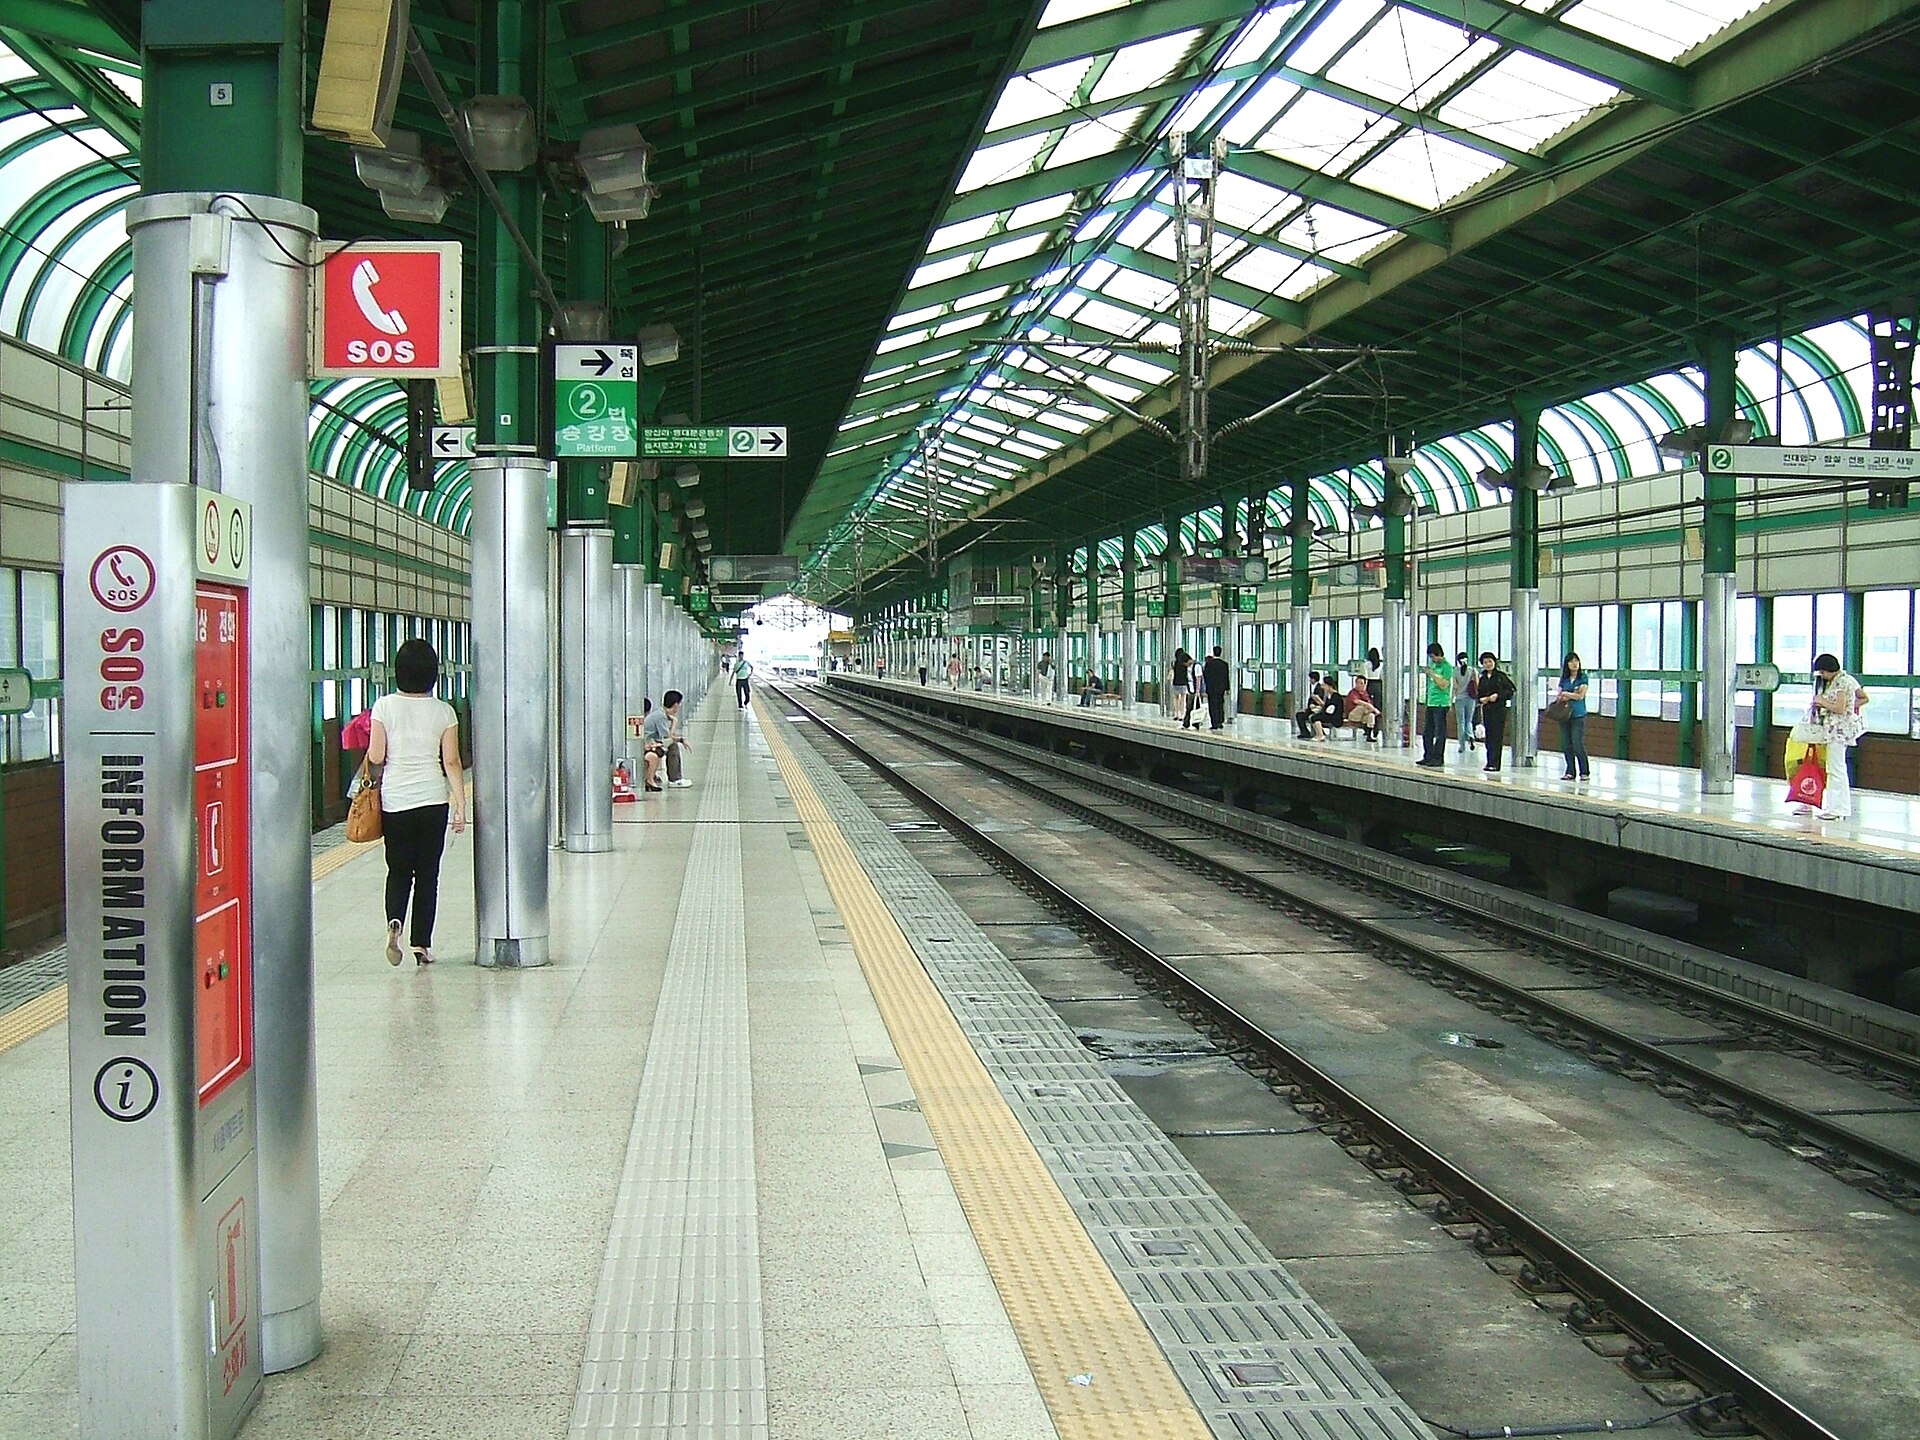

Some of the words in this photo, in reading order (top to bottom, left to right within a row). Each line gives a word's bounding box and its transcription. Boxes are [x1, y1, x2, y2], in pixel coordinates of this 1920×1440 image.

[217, 88, 226, 100] 5
[347, 340, 416, 363] SOS
[579, 389, 597, 414] 2
[608, 406, 626, 421] 번
[562, 424, 631, 442] 승강장
[734, 431, 752, 451] 2
[576, 443, 617, 453] Platform
[1714, 450, 1730, 468] 2
[107, 589, 138, 601] SOS
[220, 611, 235, 643] 전화
[100, 627, 145, 711] SOS
[101, 754, 147, 1037] INFORMATION
